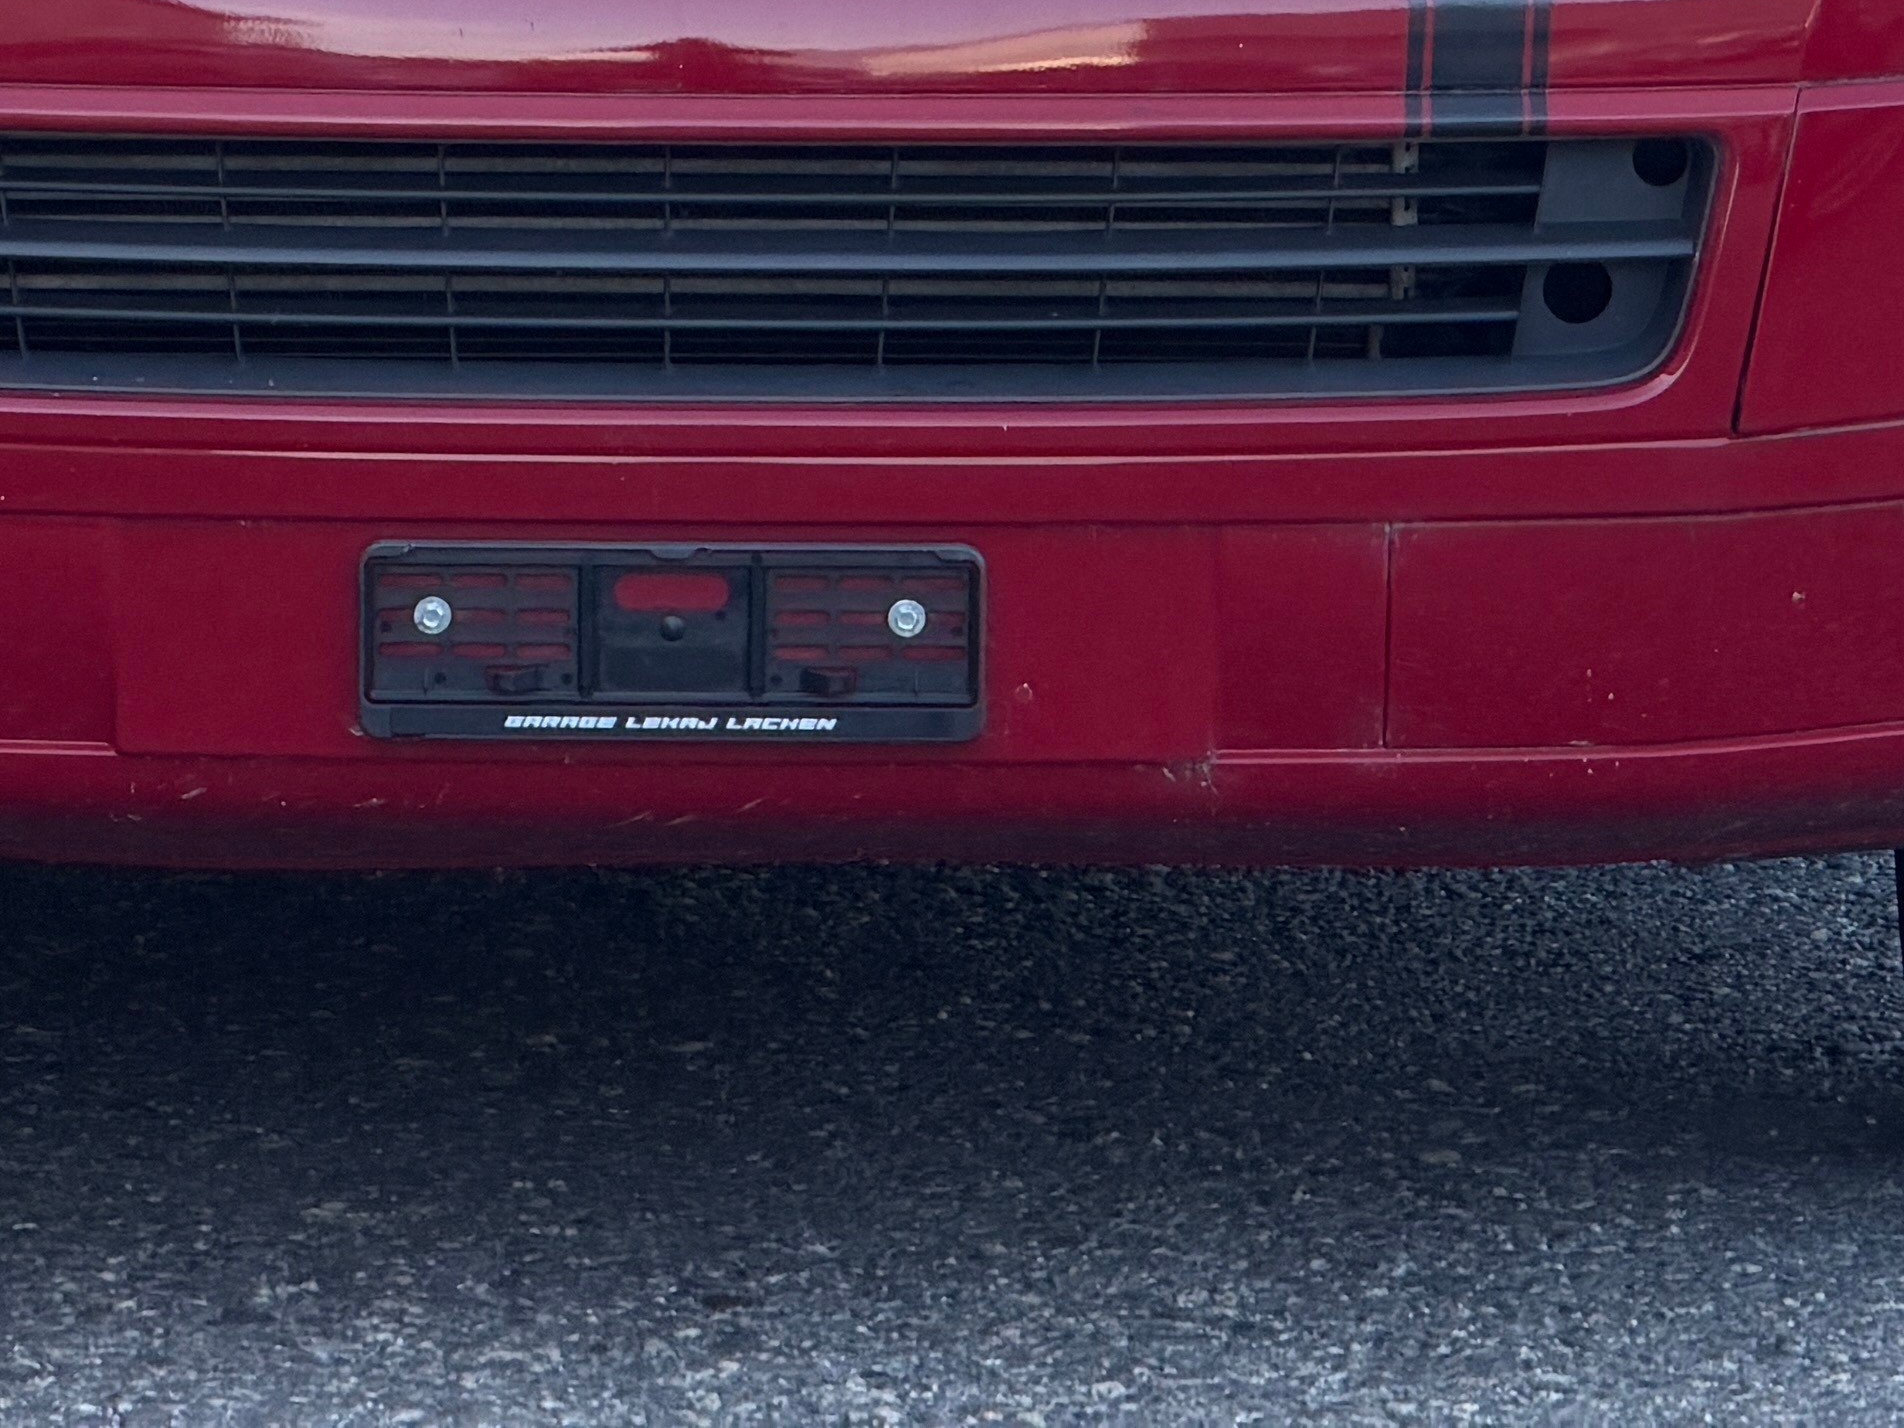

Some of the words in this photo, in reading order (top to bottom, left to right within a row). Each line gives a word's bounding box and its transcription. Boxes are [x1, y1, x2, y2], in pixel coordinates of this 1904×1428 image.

[503, 714, 617, 729] GARAGE
[624, 715, 719, 730] LEKAJ
[725, 716, 838, 731] LACHEN
